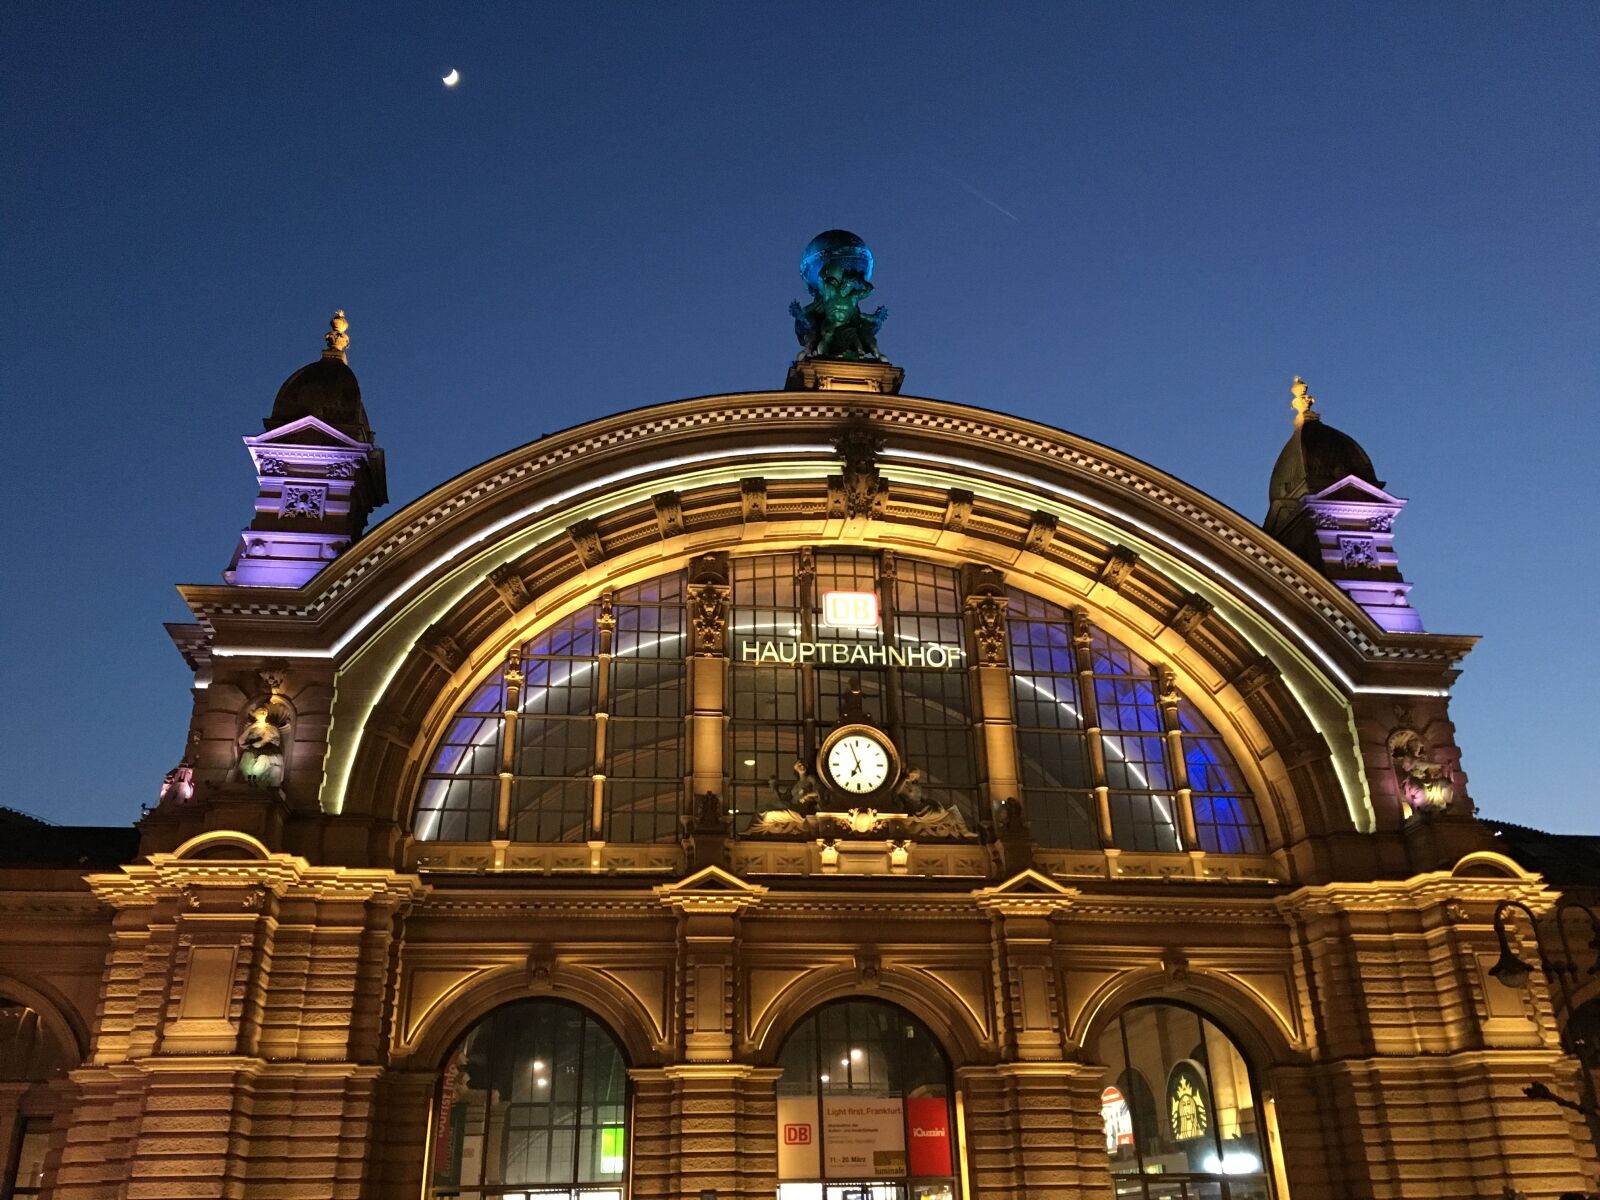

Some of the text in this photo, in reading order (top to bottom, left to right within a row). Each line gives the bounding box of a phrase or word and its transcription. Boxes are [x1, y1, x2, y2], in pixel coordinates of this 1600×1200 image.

[831, 597, 870, 621] DB
[742, 640, 961, 668] HAUPTBAHNHOF
[827, 1107, 846, 1118] Light
[787, 1126, 809, 1143] DB
